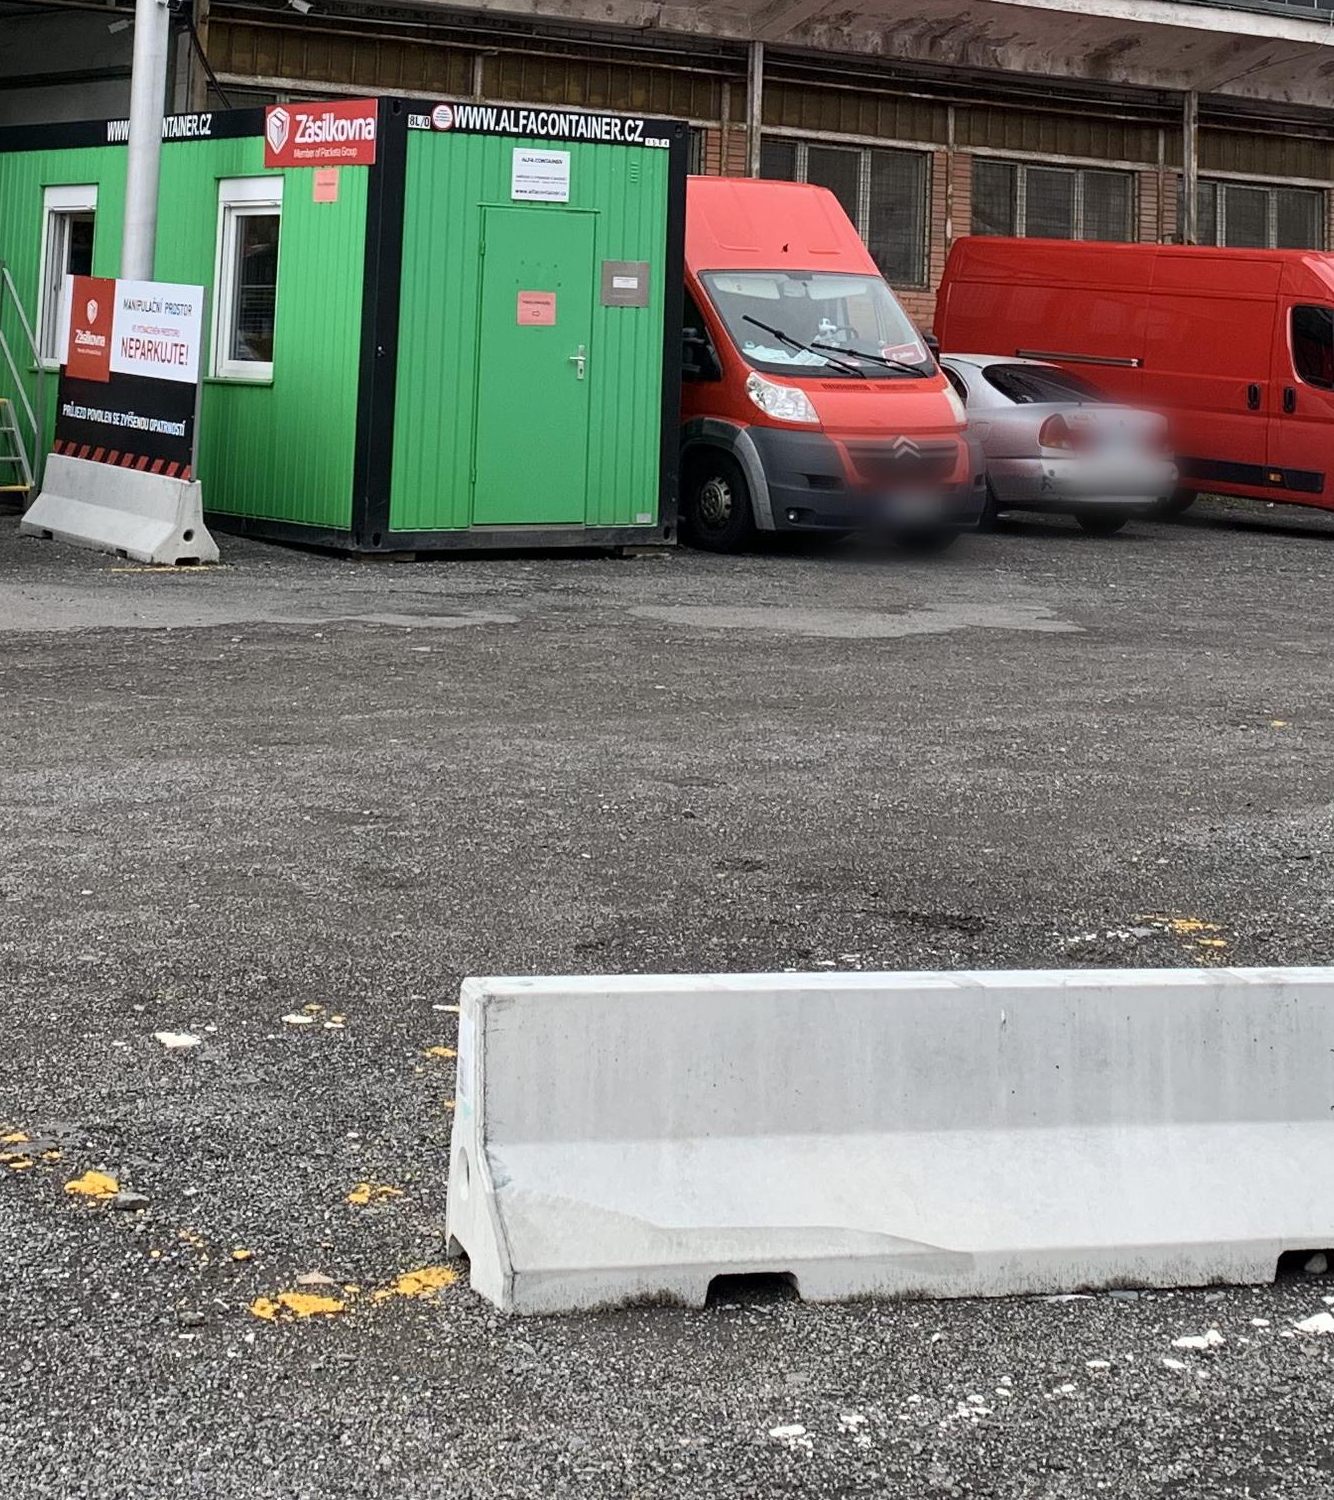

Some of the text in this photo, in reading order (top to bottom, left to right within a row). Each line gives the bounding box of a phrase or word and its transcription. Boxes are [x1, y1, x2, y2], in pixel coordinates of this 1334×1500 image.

[294, 113, 375, 144] Zásilkovna
[453, 105, 644, 142] WWW.ALFACONTAINER.CZ
[341, 146, 357, 157] Group
[123, 296, 193, 316] MANIPULAČNÍ PROSTOR
[120, 337, 189, 366] NEPARKUJTE!
[62, 401, 186, 437] PRŮJEZD POVOLEN SE ZVÝŠENOU OPATRNOSTÍ
